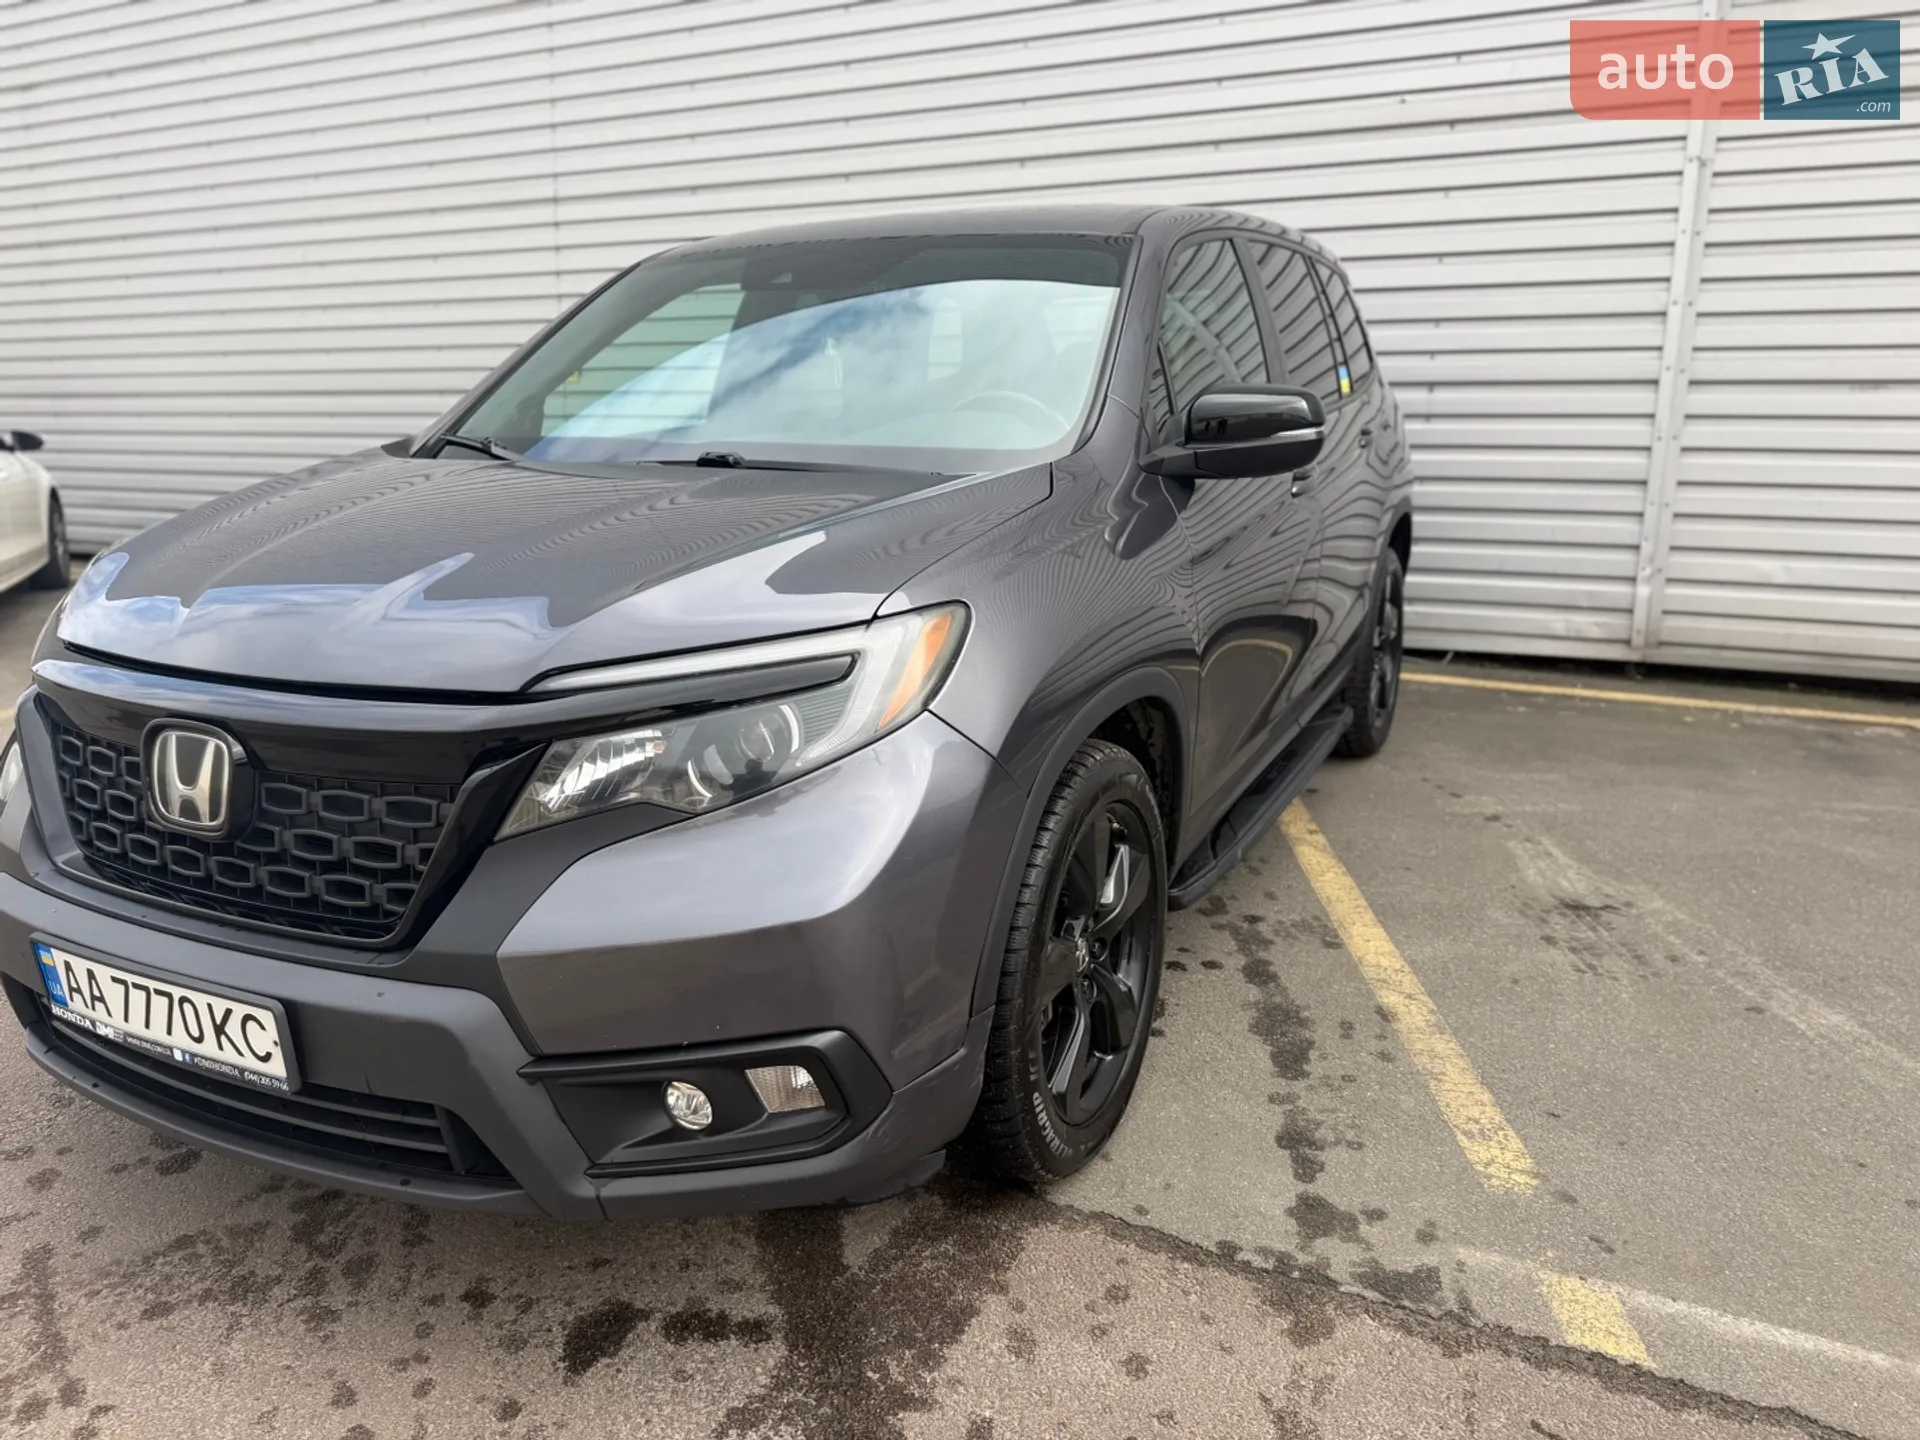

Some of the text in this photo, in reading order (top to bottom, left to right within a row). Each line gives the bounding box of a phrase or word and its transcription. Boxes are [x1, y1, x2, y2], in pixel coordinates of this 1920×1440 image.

[48, 980, 64, 998] UA
[51, 1004, 95, 1032] HONDA
[63, 959, 273, 1064] AA 7770 KC
